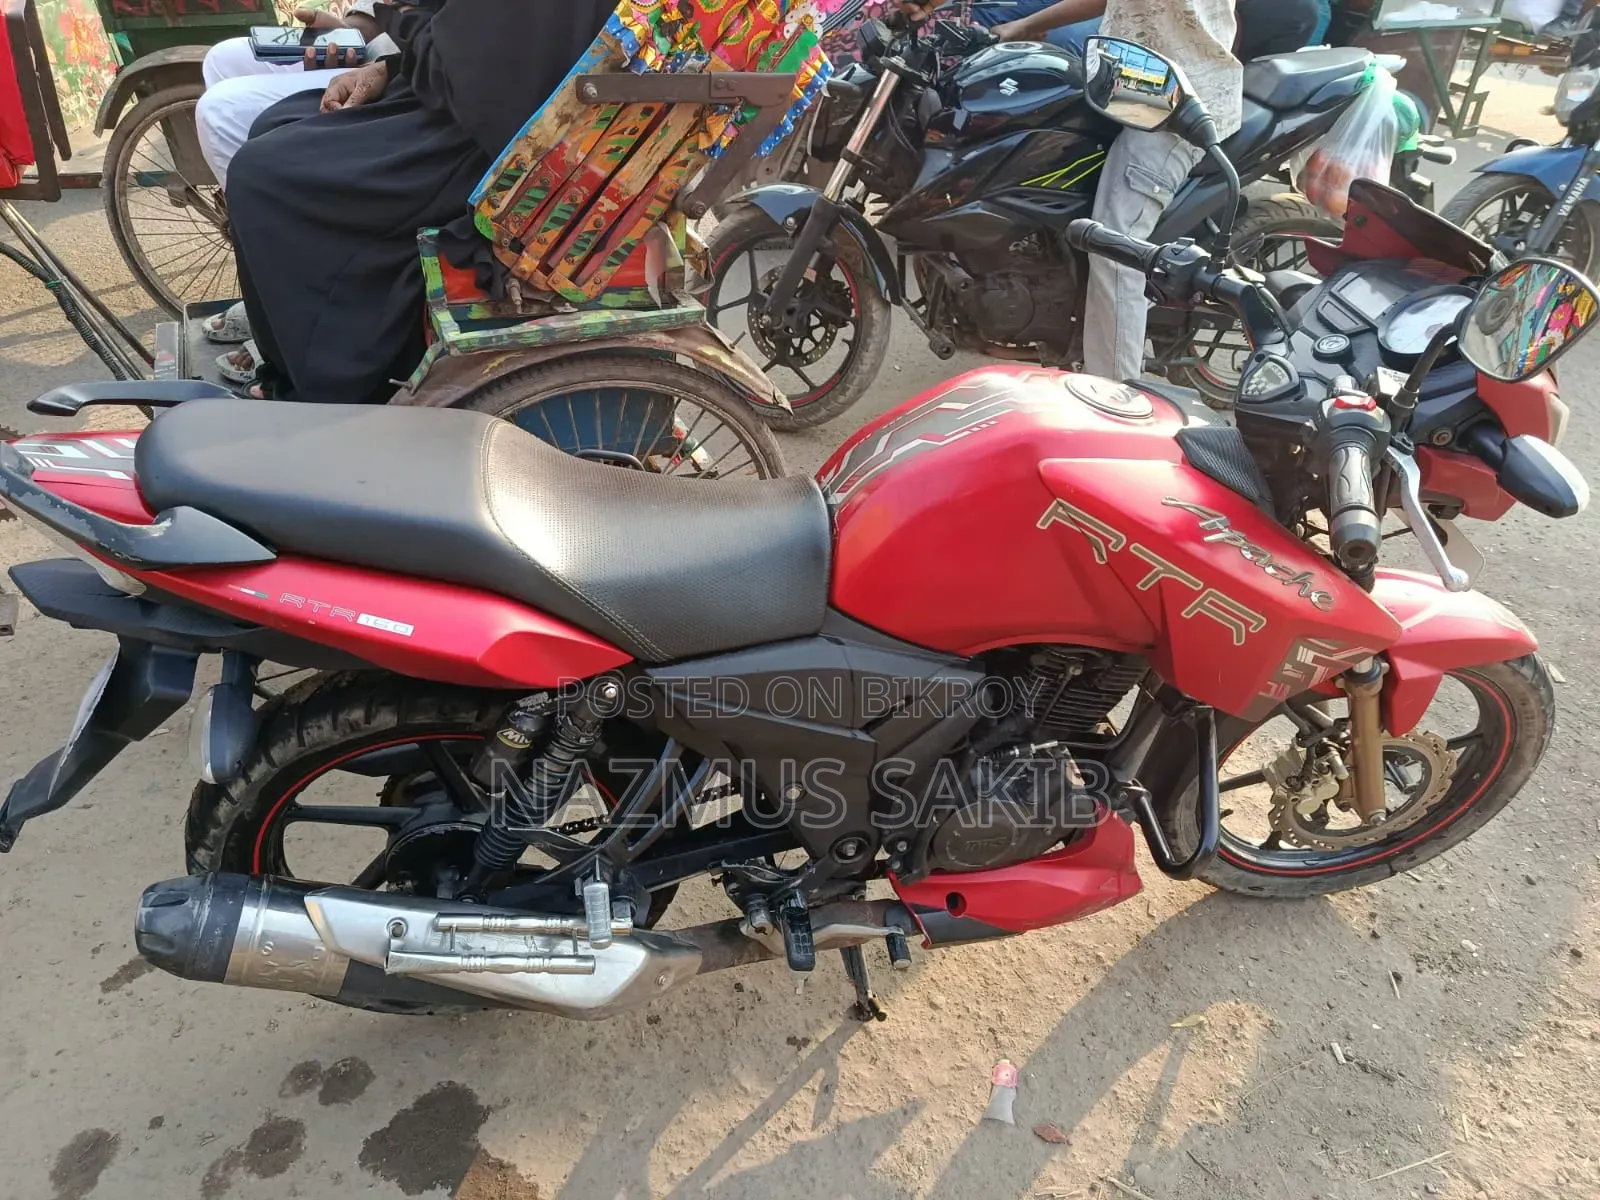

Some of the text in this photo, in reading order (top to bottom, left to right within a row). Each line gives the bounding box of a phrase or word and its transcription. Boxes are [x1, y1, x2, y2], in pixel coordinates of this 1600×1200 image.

[1557, 177, 1590, 216] YAMAHA
[1036, 497, 1267, 646] RTR
[1161, 495, 1335, 612] Apache
[279, 592, 411, 634] RTR 160
